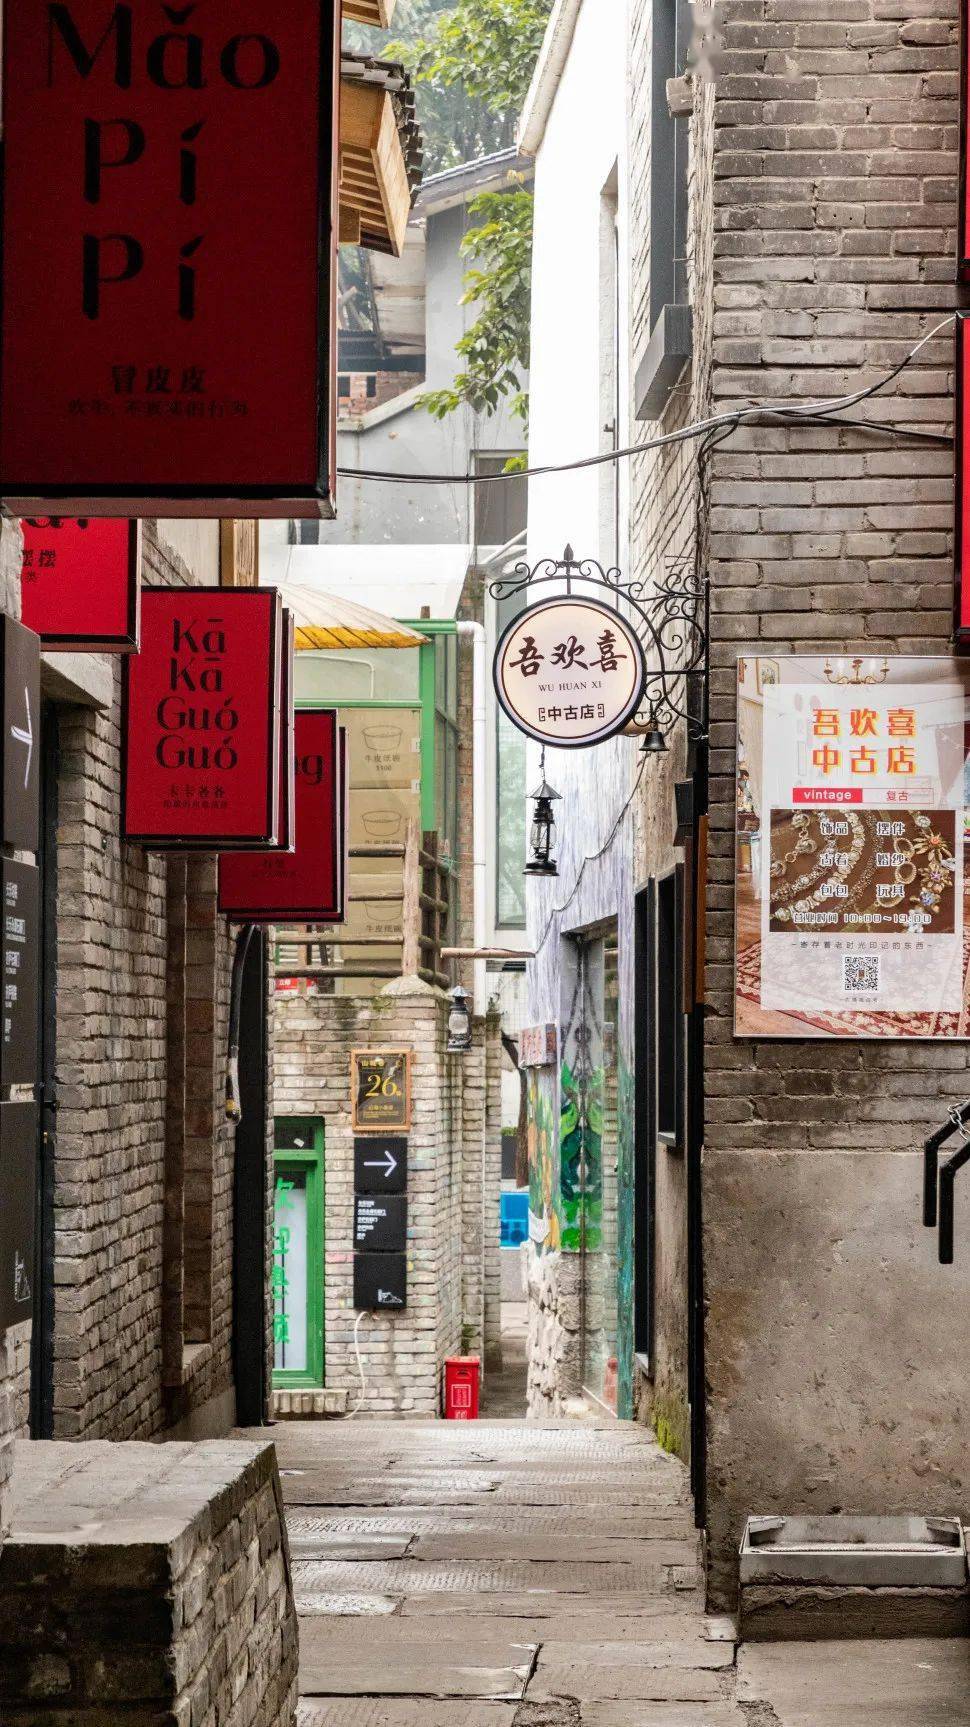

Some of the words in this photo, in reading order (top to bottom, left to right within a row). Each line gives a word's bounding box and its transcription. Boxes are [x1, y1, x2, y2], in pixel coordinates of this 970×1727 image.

[83, 118, 206, 206] Pí
[82, 234, 206, 320] Pí
[172, 618, 226, 653] Kā
[509, 629, 628, 678] 吾欢喜
[169, 656, 223, 691] Kā
[538, 683, 555, 692] WU
[559, 681, 587, 691] HUAN
[591, 680, 602, 689] XI
[156, 696, 239, 731] Guó
[547, 702, 595, 721] 中古店
[812, 708, 915, 737] 吾欢喜
[156, 735, 238, 770] Guó
[811, 743, 915, 774] 中古店
[803, 790, 852, 802] vintage
[886, 790, 909, 802] 复古
[820, 821, 849, 835] 饰品
[876, 821, 905, 835] 摆件
[820, 852, 849, 867] 古着
[876, 852, 905, 867] 婚纱
[820, 884, 849, 898] 包包
[876, 884, 905, 898] 玩具
[793, 912, 839, 924] 营业时间
